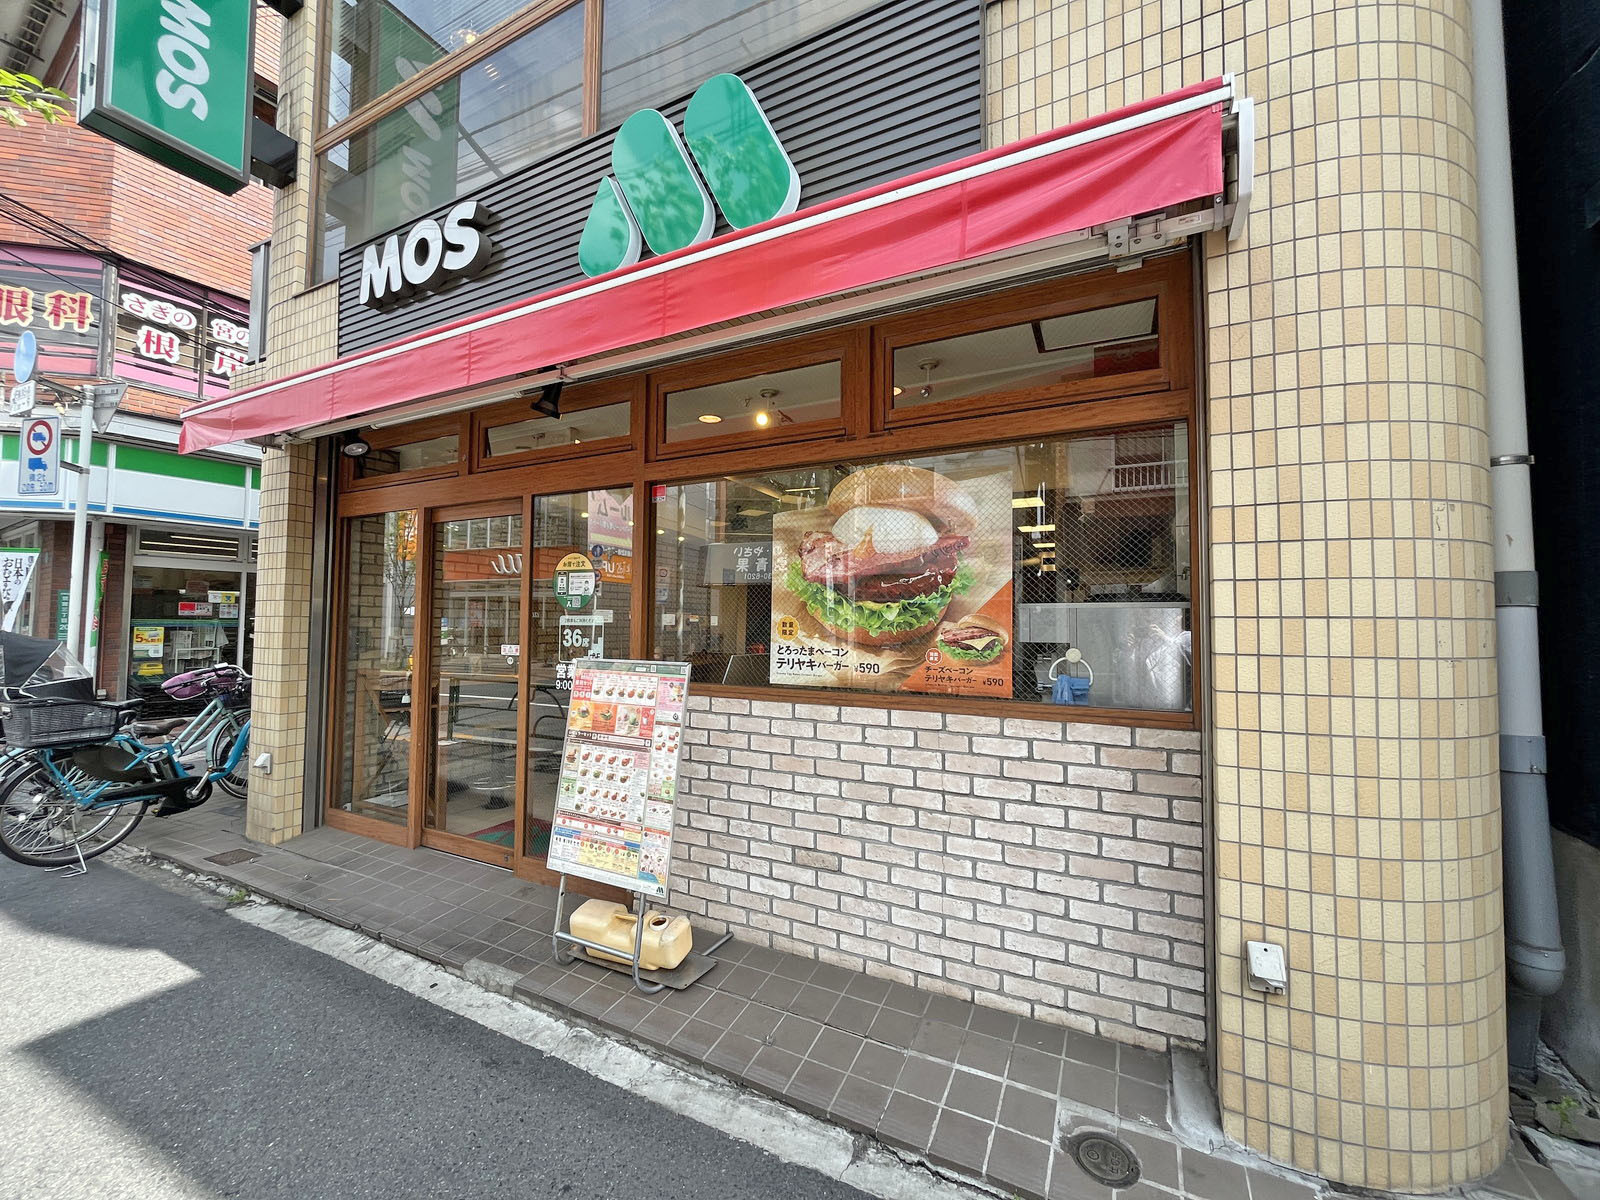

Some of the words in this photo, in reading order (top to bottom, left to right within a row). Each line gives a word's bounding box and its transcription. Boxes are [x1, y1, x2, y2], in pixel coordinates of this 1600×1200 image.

[155, 0, 211, 121] MOS
[359, 201, 480, 305] MOS
[125, 295, 194, 327] さぎの
[141, 328, 177, 360] 根
[13, 558, 24, 585] 日本の
[776, 645, 849, 657] とろったまベーコン
[776, 657, 849, 671] テリヤキバーガー
[853, 662, 880, 674] ¥590
[925, 666, 974, 675] チーズベーコン
[924, 674, 977, 683] テリヤキバーガー
[982, 677, 1004, 687] ¥590
